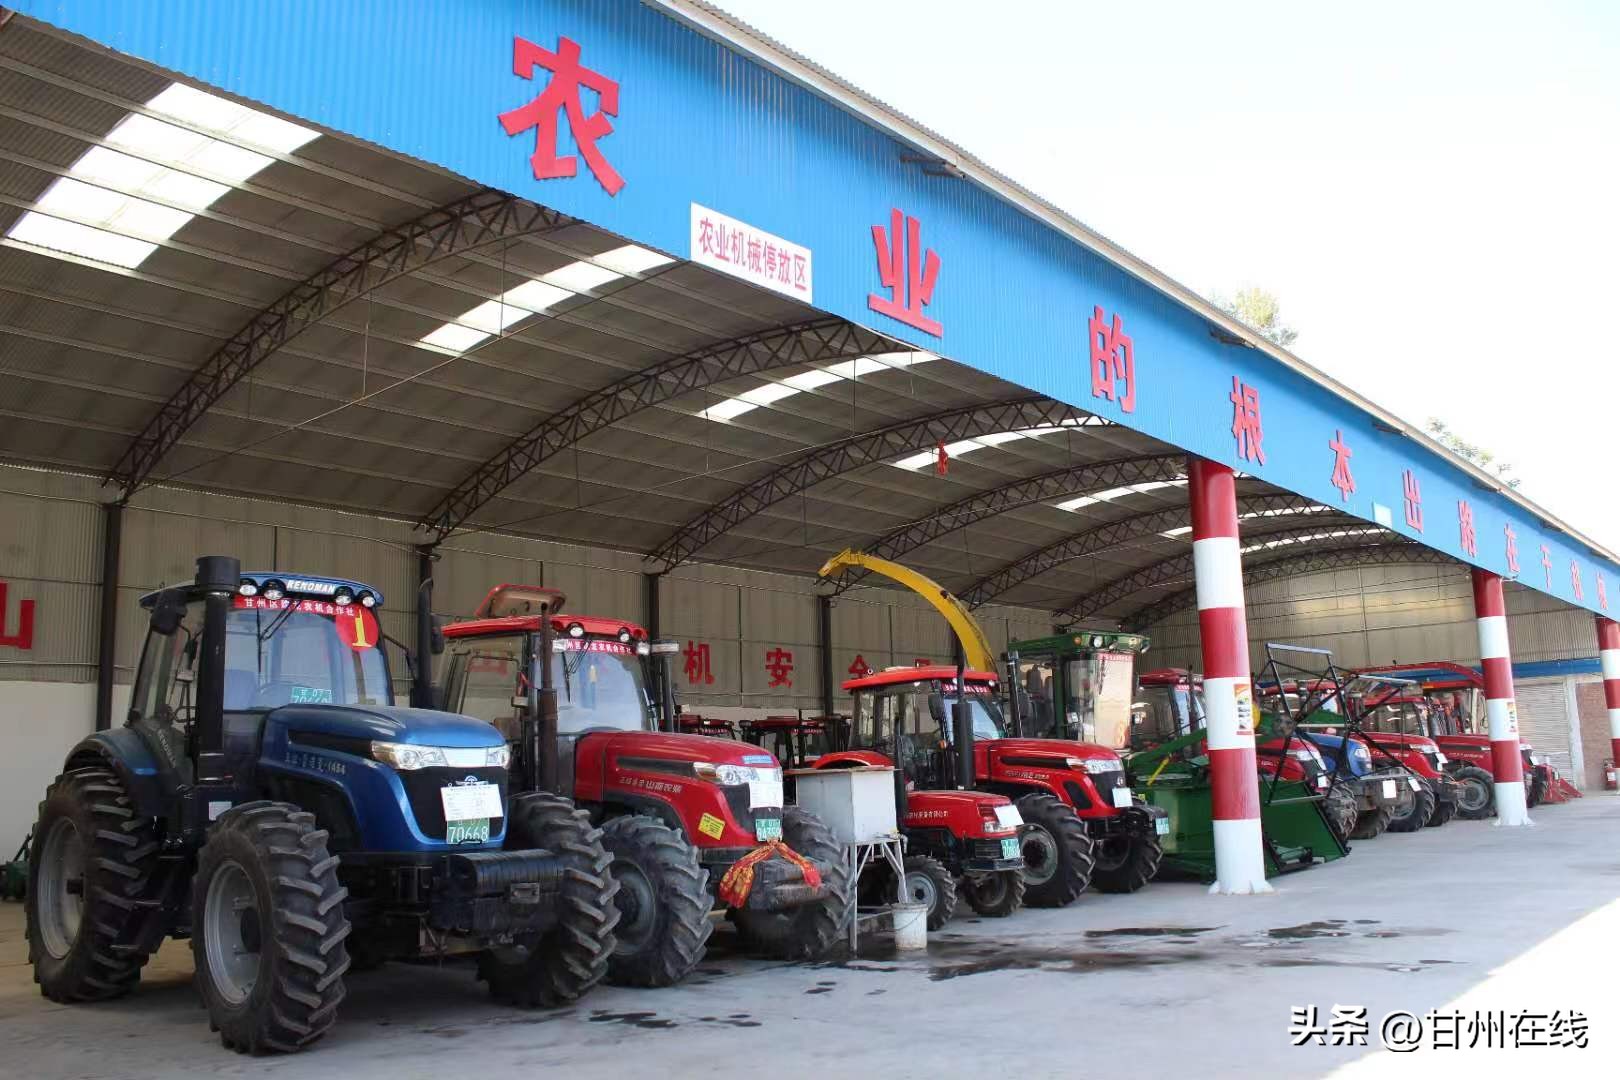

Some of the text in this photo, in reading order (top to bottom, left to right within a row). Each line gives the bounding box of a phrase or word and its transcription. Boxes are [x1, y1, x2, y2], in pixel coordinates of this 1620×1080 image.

[698, 216, 808, 291] 农业机械停放区
[351, 608, 373, 647] 1
[448, 825, 488, 843] 70668
